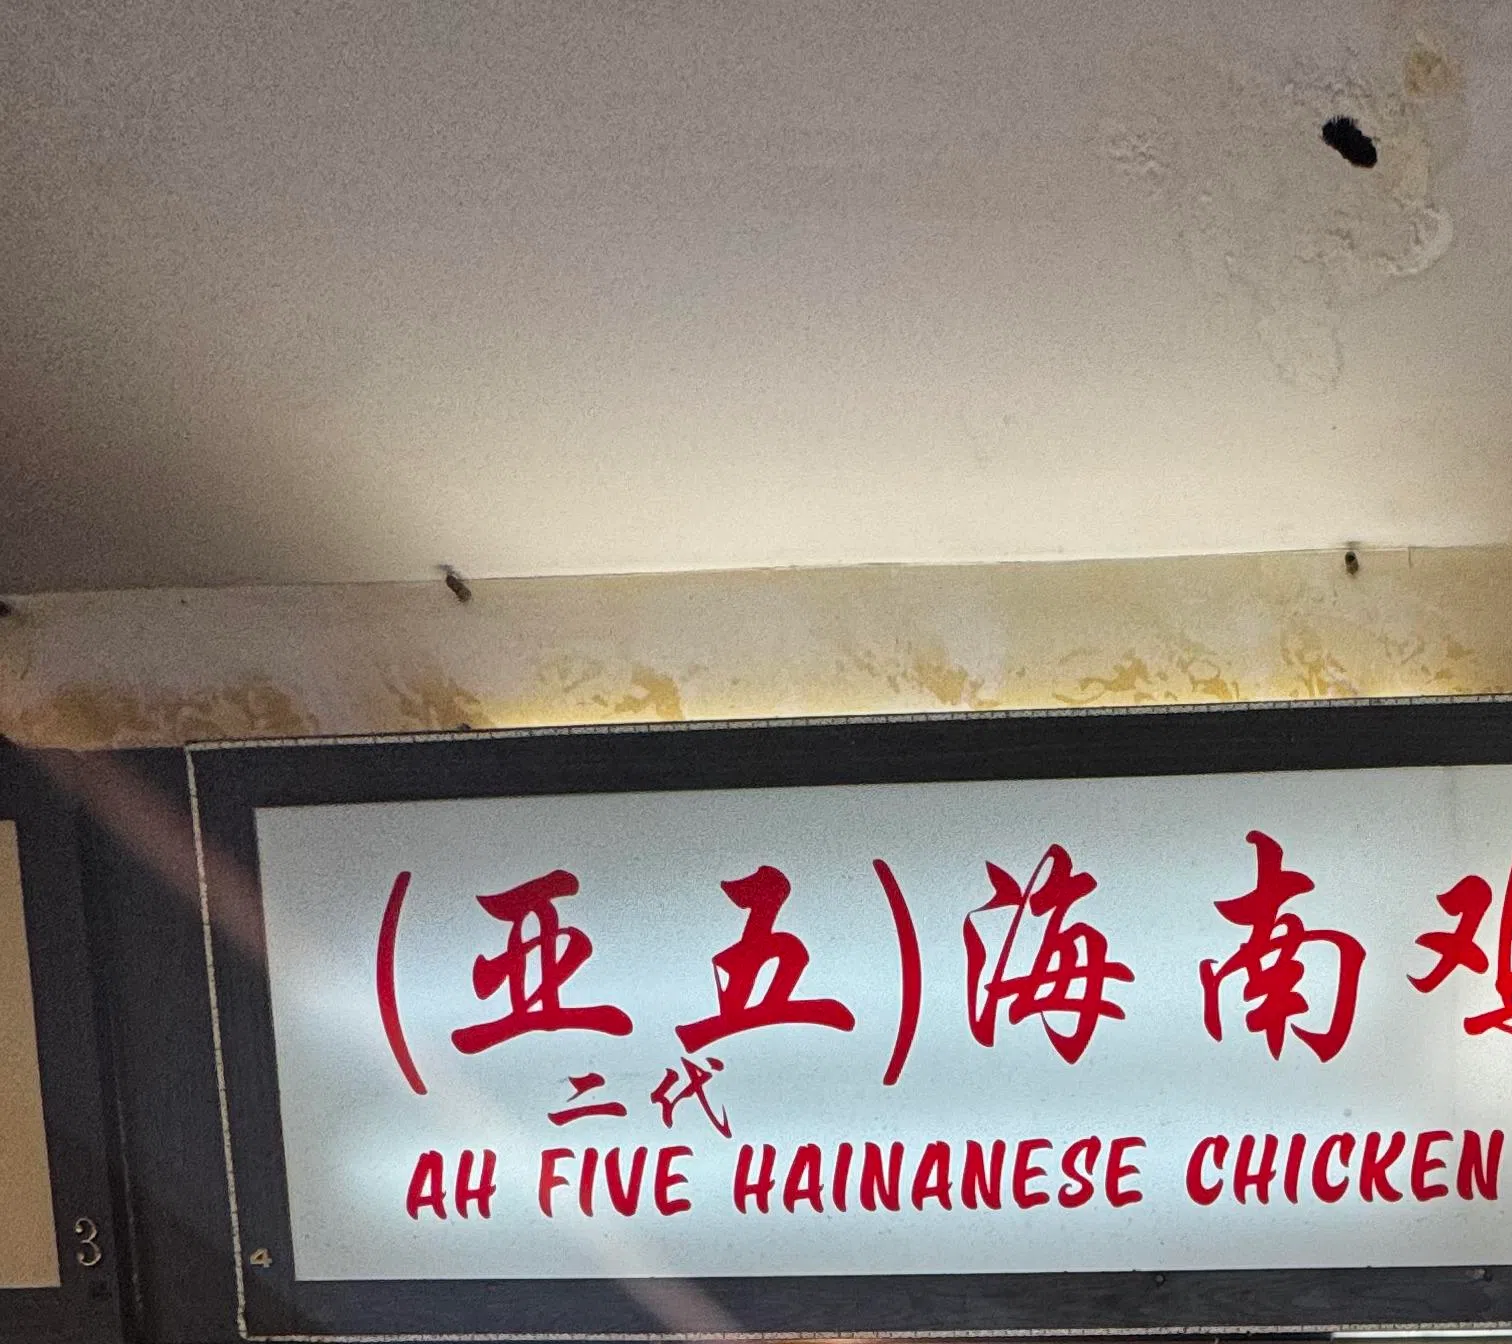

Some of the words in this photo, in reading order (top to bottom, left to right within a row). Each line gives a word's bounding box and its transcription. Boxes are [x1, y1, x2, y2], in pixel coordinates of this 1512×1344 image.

[548, 1056, 733, 1139] 二代
[405, 1150, 498, 1220] AH
[538, 1146, 692, 1219] FIVE
[732, 1135, 1146, 1214] HAINANESE
[1185, 1127, 1505, 1206] CHICKEN
[75, 1217, 101, 1266] 3
[250, 1248, 272, 1267] 4
